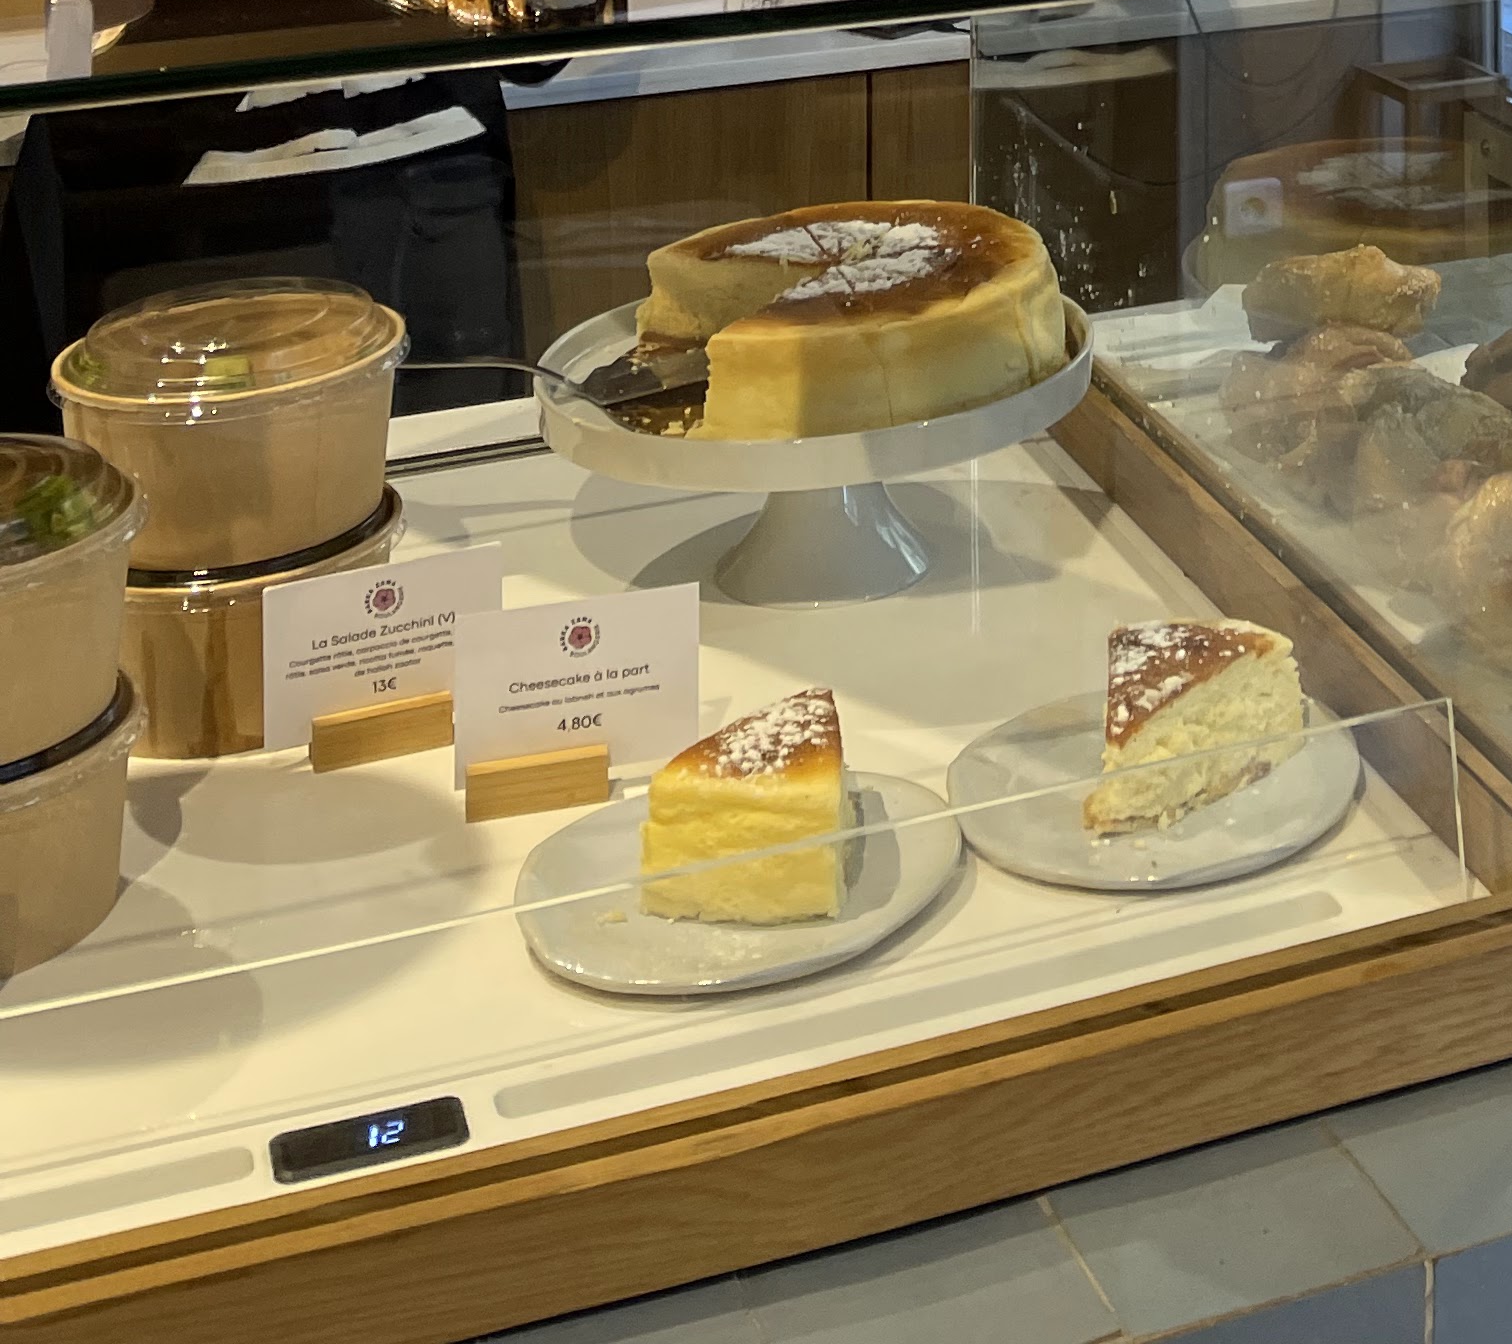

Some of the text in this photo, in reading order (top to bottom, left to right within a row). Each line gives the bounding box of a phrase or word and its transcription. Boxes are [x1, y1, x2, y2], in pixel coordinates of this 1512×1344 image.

[312, 611, 456, 650] La Salade Zucchini (V)
[372, 677, 397, 694] 13€
[509, 663, 650, 694] Cheesecake à la part
[557, 712, 603, 733] 4,80€
[368, 1119, 405, 1148] 12
